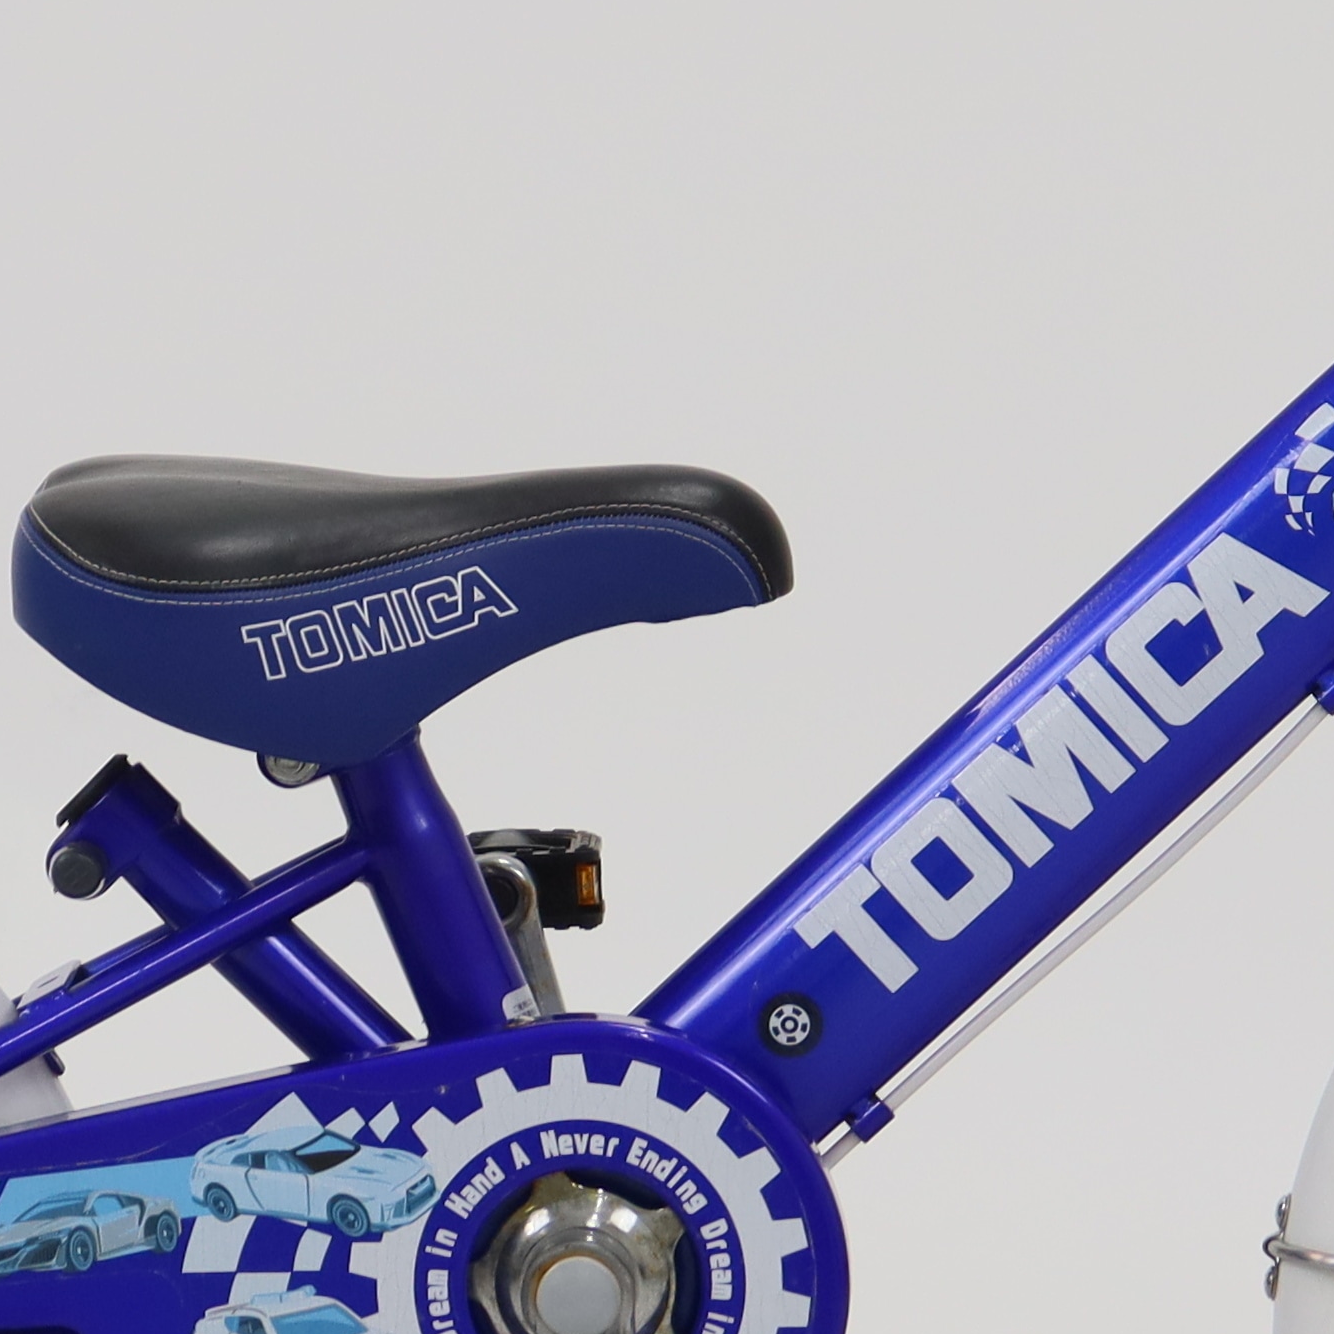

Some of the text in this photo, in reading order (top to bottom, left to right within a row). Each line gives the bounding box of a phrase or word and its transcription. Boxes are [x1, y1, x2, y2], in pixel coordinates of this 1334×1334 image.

[241, 565, 519, 681] TOMICA
[793, 531, 1331, 994] TOMICA
[424, 1228, 458, 1258] in
[444, 1156, 506, 1220] Hand
[510, 1141, 531, 1170] A
[539, 1129, 620, 1159] Never
[625, 1136, 708, 1215] Ending
[700, 1217, 734, 1301] Dream
